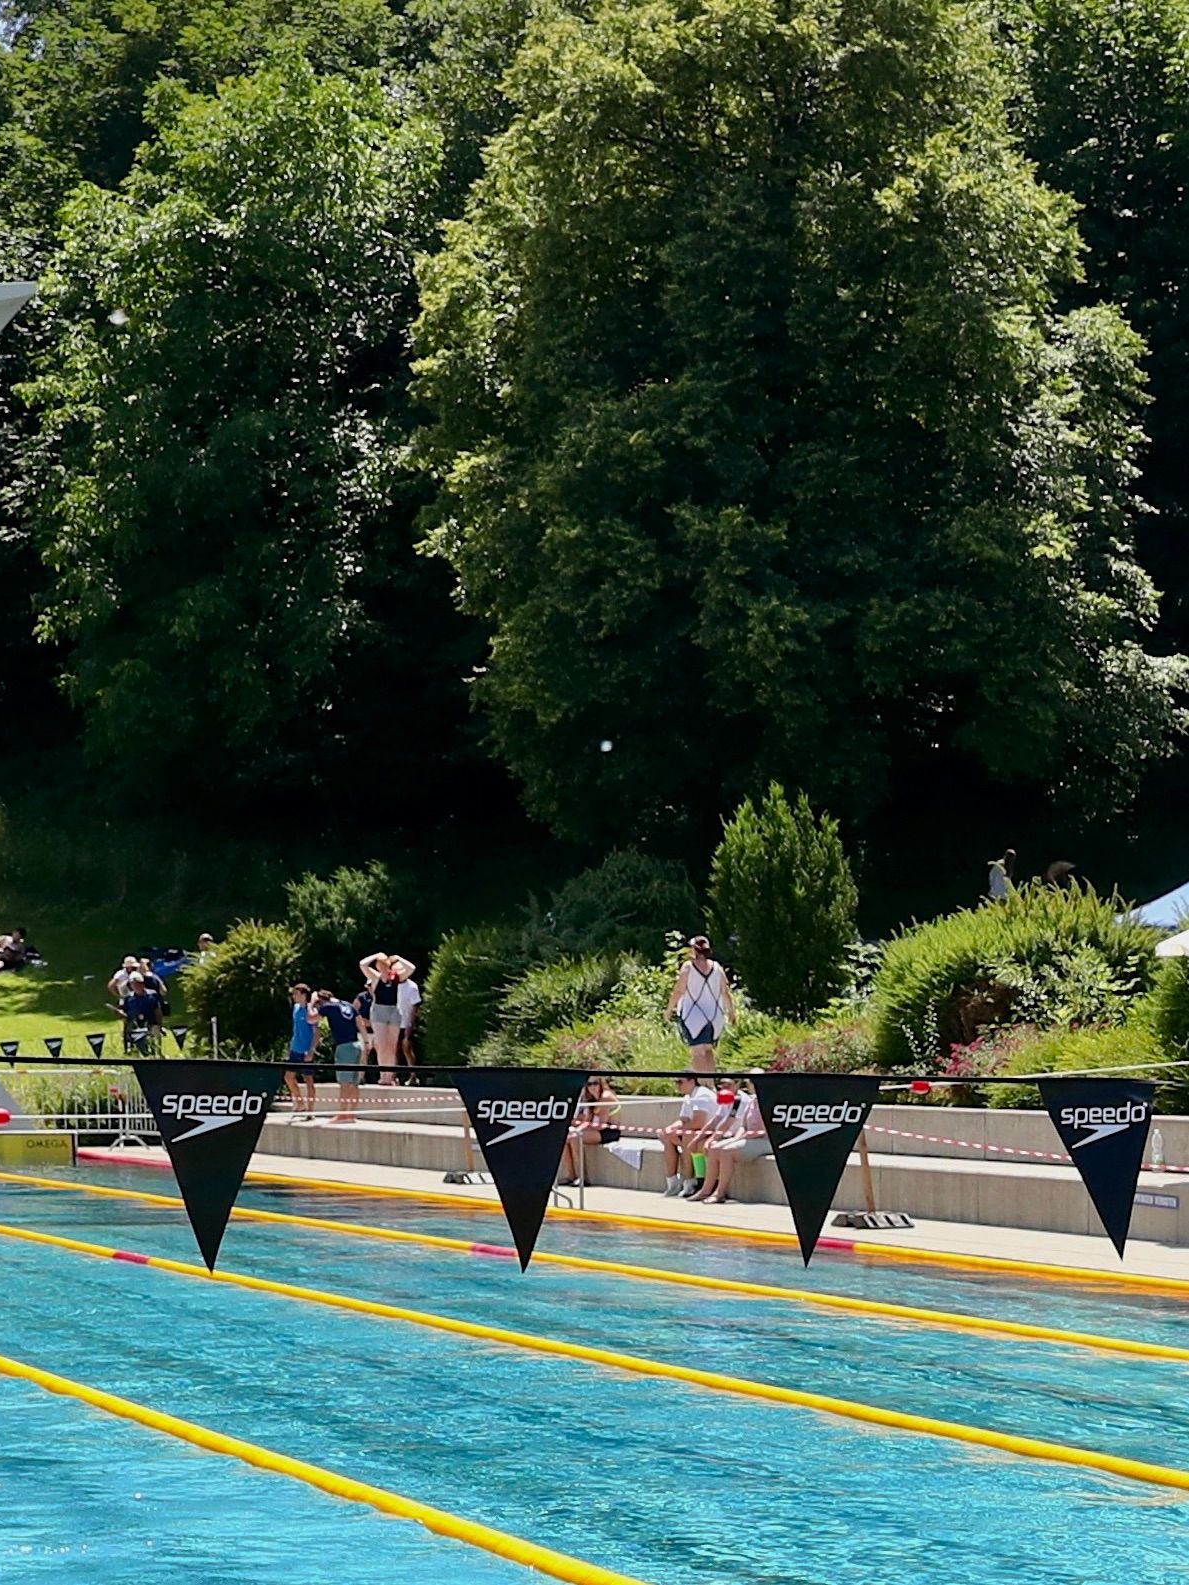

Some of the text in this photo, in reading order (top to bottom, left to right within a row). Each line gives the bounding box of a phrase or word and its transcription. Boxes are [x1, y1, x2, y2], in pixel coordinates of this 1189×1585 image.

[162, 1090, 263, 1119] speedo
[478, 1096, 569, 1124] speedo
[772, 1101, 862, 1127] speedo
[1061, 1102, 1146, 1129] speedo
[26, 1139, 68, 1149] OMEGA
